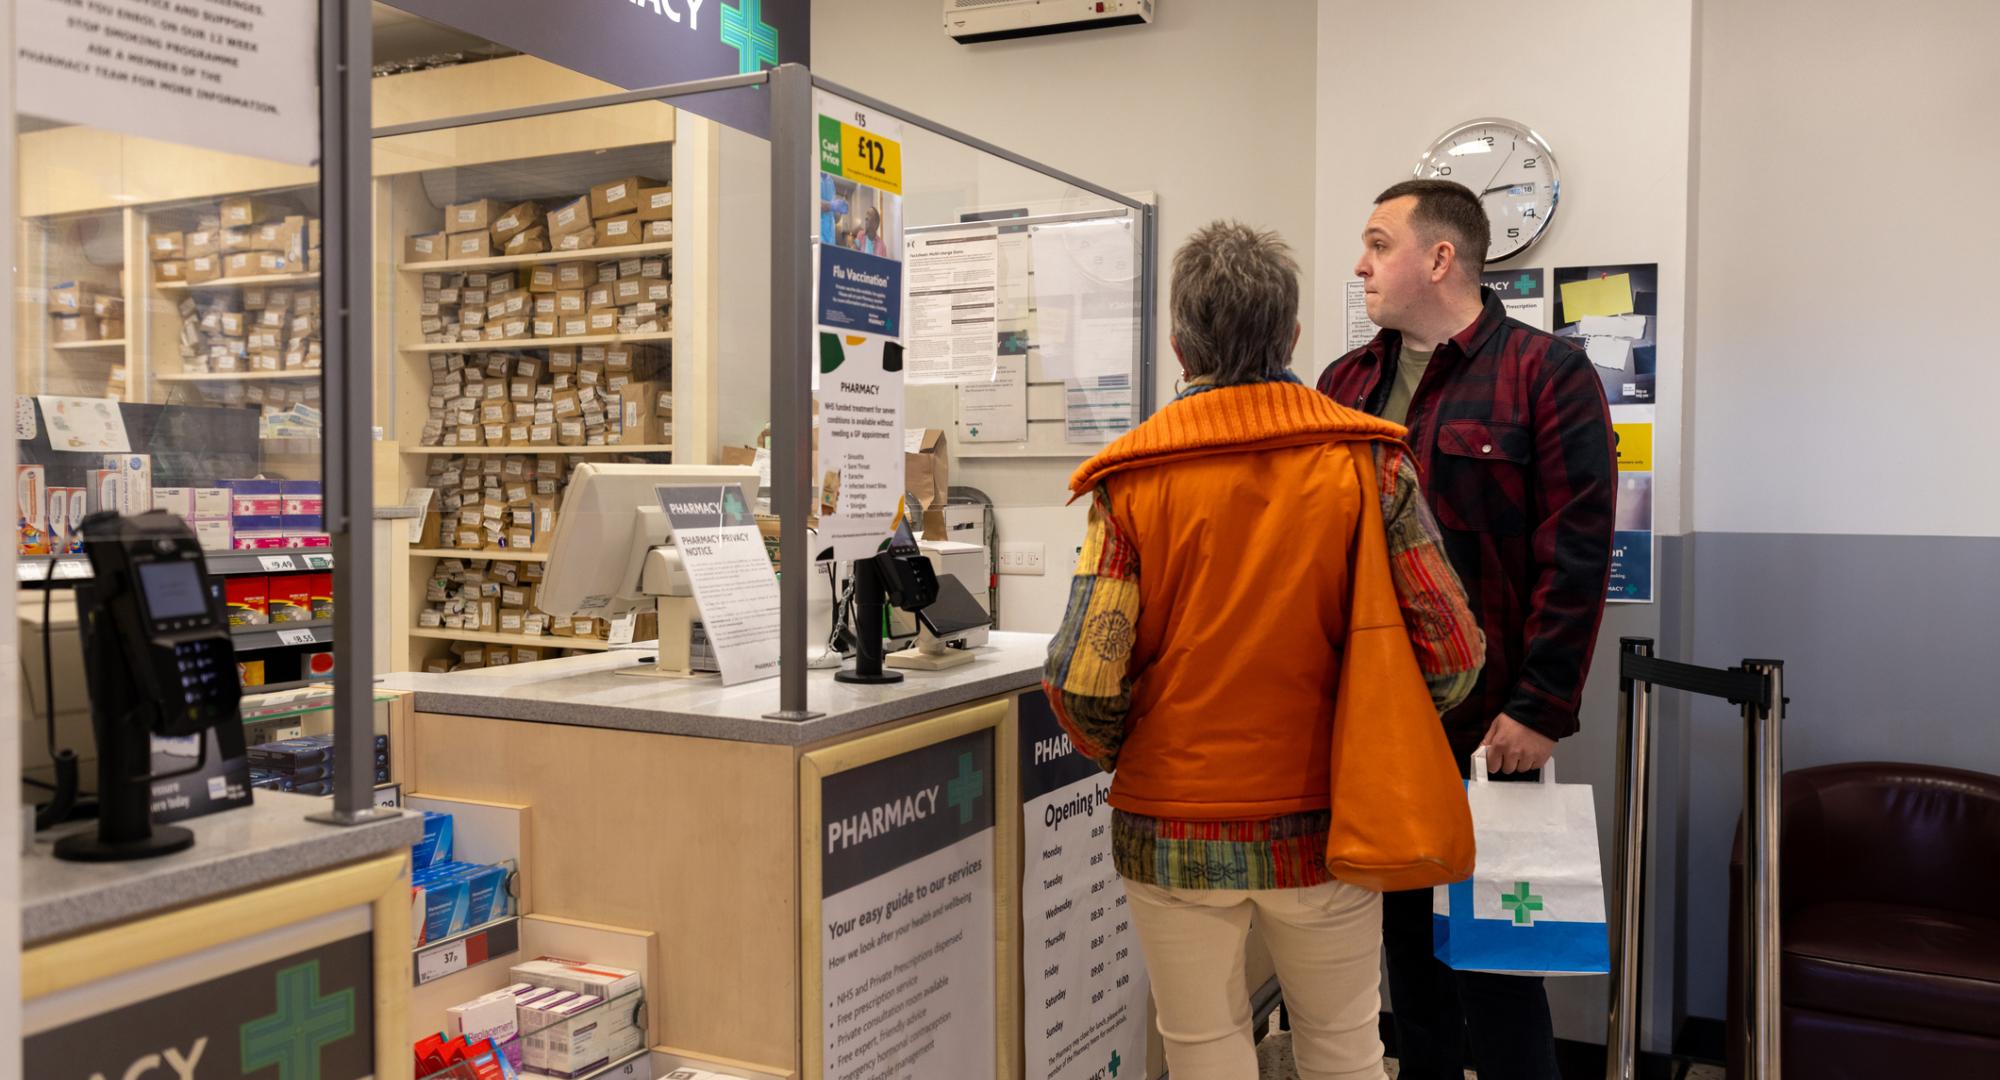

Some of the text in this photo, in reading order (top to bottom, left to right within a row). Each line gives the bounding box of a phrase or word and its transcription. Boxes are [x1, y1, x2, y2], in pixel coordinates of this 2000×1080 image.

[87, 1, 259, 53] YOU ENROL ON OUR 12 WEEK
[174, 4, 253, 31] AND SUPPORT
[67, 16, 239, 68] STOP SMOKING PROGRAMME
[87, 43, 222, 83] ASK A MEMBER OF THE
[19, 49, 280, 116] PHARMACY TEAM FOR MORE INFORMATION.
[822, 139, 840, 154] Card
[822, 151, 840, 166] Price
[858, 136, 886, 174] £12
[1523, 158, 1537, 169] 2
[1523, 208, 1537, 219] 4
[1507, 228, 1520, 239] 5
[833, 265, 846, 279] Flu
[840, 382, 880, 395] PHARMACY
[825, 402, 834, 411] NHS
[835, 403, 851, 412] funded
[852, 404, 874, 413] treatment
[827, 417, 850, 425] conditions
[831, 430, 849, 439] needing
[862, 431, 890, 440] appointment
[669, 502, 721, 516] PHARMACY
[681, 533, 750, 545] PHARMACY PRIVACY
[685, 546, 713, 557] NOTICE
[754, 662, 777, 670] PHARMACY
[1034, 733, 1073, 766] PHAR
[828, 785, 940, 854] PHARMACY
[1045, 783, 1111, 831] Opening ho
[1042, 825, 1104, 860] Monday 08:30
[1043, 852, 1103, 891] Tuesday 08:30
[829, 858, 982, 940] Your easy guide to our services
[1045, 880, 1104, 921] Wednesday 08:30
[828, 891, 972, 970] How we look after your health and wellbeing
[1044, 931, 1066, 949] Thursday
[1090, 907, 1104, 922] 08:30
[444, 952, 458, 964] 37p
[837, 929, 964, 1006] NHS and Private Prescriptions dispensed
[1044, 964, 1060, 980] Friday
[1091, 935, 1104, 950] 08:30
[837, 975, 919, 1027] Free prescription service
[1045, 988, 1066, 1009] Saturday
[1090, 962, 1104, 977] 09:00
[837, 975, 949, 1047] Private consultation room available
[1046, 1020, 1064, 1039] Sunday
[1091, 990, 1104, 1004] 10:00
[468, 1020, 514, 1043] Replacement
[837, 1008, 927, 1067] Free expert, friendly advice
[877, 1035, 909, 1062] hormonal
[910, 1011, 951, 1043] contraception
[895, 1039, 935, 1072] management
[1047, 1064, 1062, 1079] member
[1073, 1042, 1090, 1057] Pharmacy
[1056, 1044, 1073, 1059] Pharmacy
